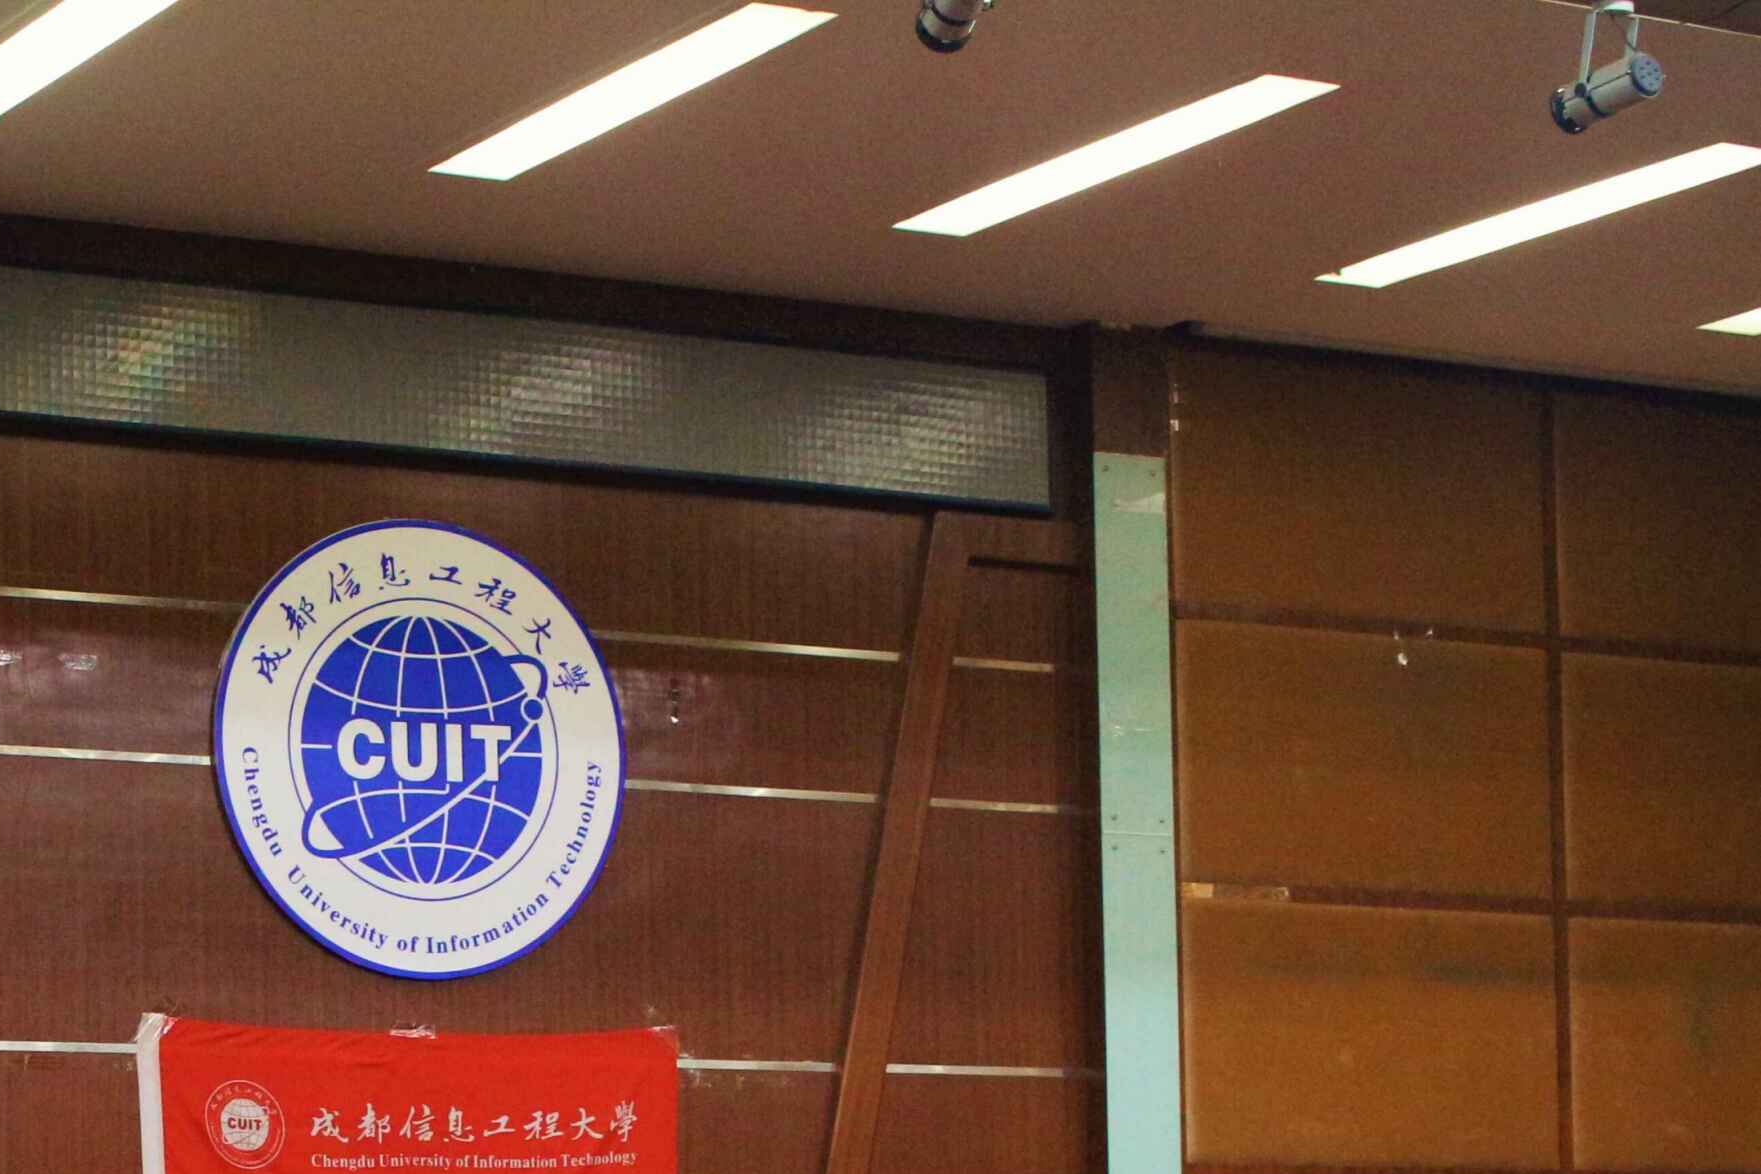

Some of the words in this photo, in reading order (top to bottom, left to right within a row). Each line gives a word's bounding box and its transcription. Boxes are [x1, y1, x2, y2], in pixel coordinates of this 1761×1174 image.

[337, 718, 512, 782] CUIT
[242, 747, 283, 857] Chengdu
[288, 865, 389, 949] University
[397, 936, 419, 953] of
[426, 892, 550, 953] Information
[545, 761, 602, 889] Technology
[227, 1117, 262, 1131] CUIT
[311, 1153, 375, 1171] Chengdu
[379, 1153, 452, 1170] University
[456, 1154, 470, 1168] of
[474, 1154, 557, 1169] Information
[560, 1150, 639, 1167] Technology
